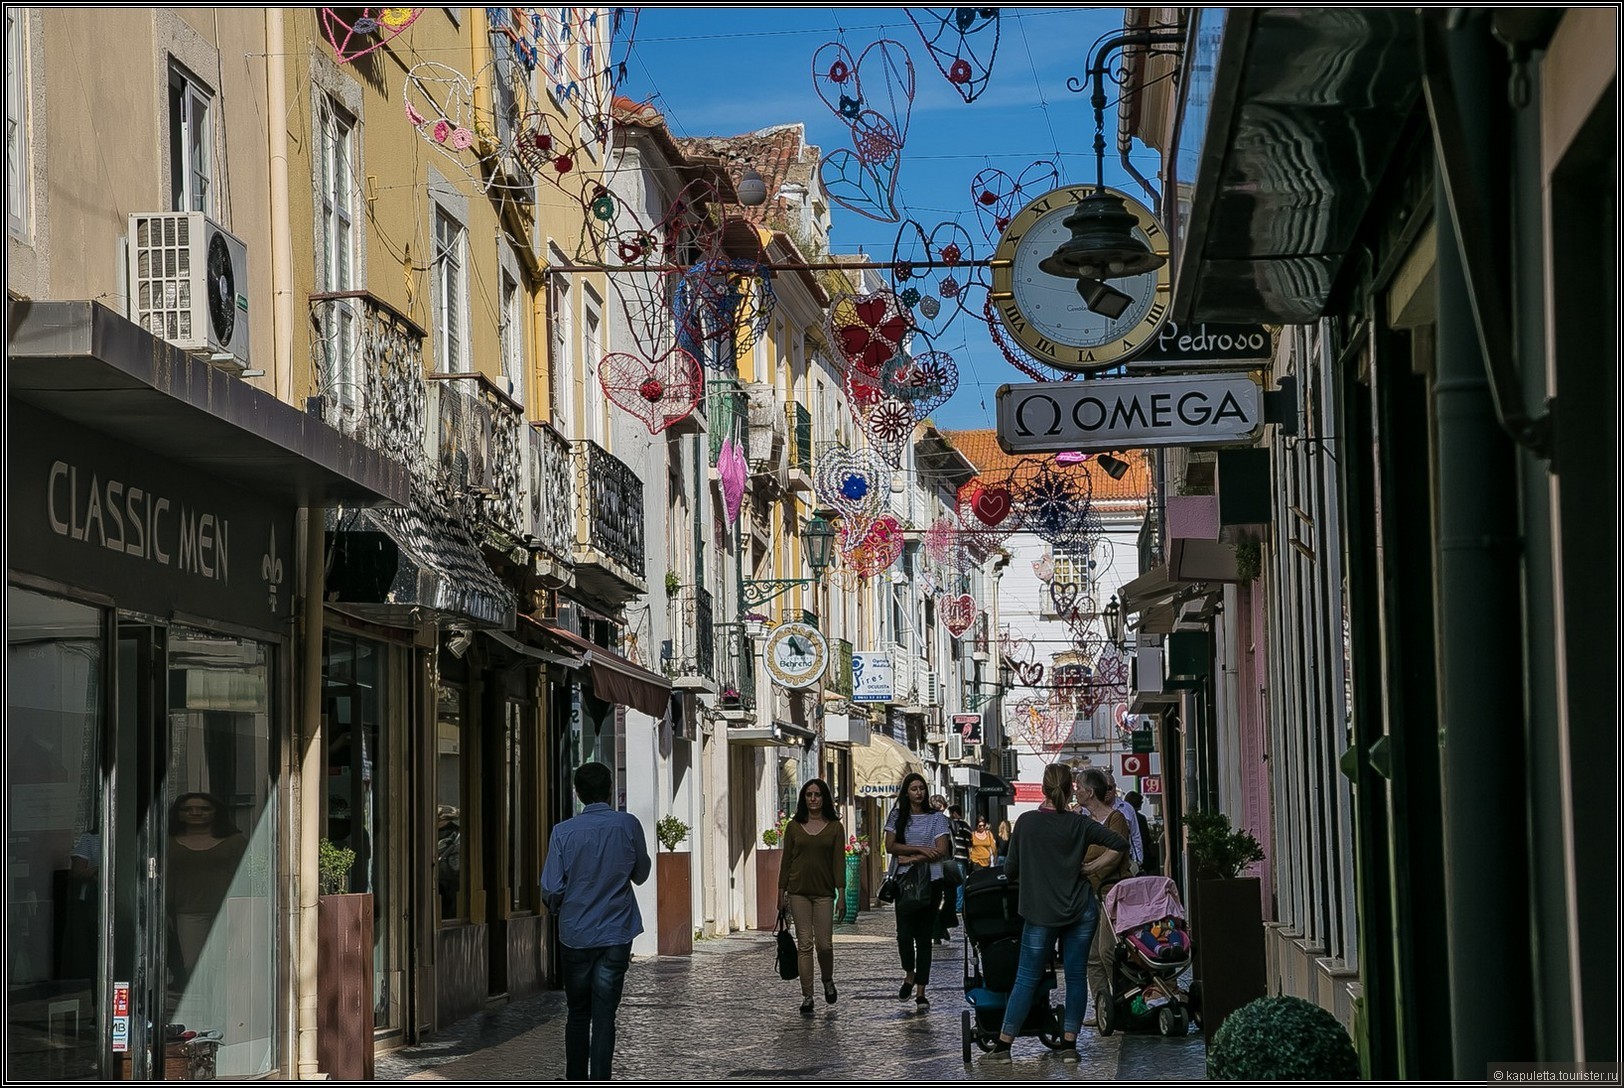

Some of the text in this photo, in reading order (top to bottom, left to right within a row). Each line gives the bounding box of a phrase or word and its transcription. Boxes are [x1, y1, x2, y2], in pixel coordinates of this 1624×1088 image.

[1029, 199, 1052, 219] XI
[1158, 319, 1264, 352] Pedroso
[1071, 389, 1250, 431] OMEGA
[48, 460, 229, 587] CLASSIC MEN
